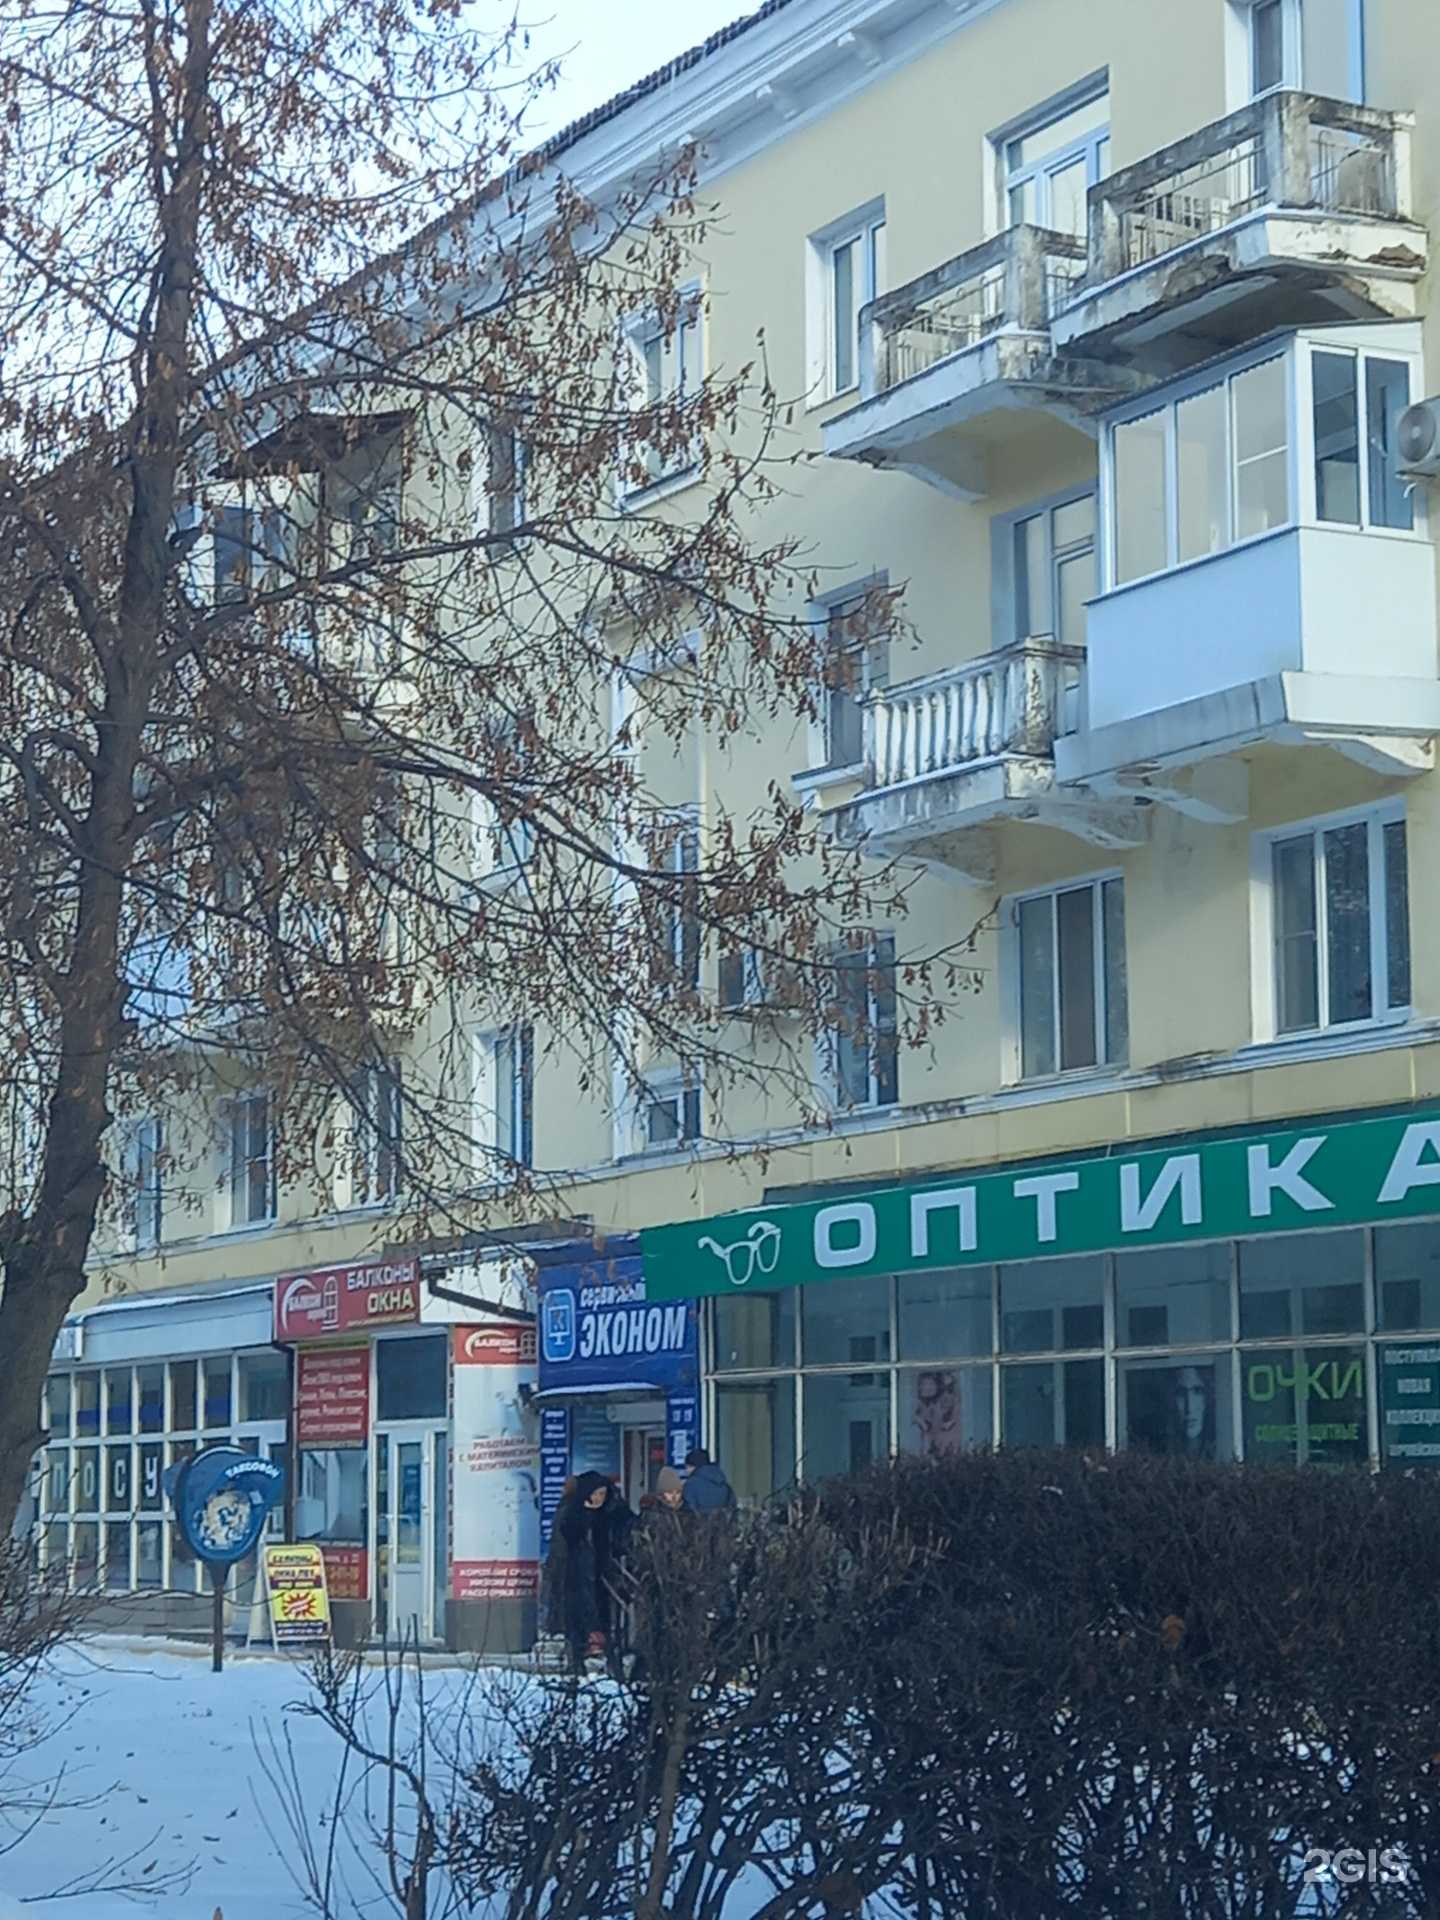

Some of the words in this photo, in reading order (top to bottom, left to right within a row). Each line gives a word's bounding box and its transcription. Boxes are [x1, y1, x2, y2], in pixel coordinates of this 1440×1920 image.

[814, 1120, 1440, 1268] ОПТИКА
[346, 1261, 415, 1291] БАЛКОНЫ
[367, 1287, 415, 1314] ОКНА
[579, 1305, 687, 1358] ЭКОНОМ
[1249, 1360, 1363, 1402] ОЧКИ
